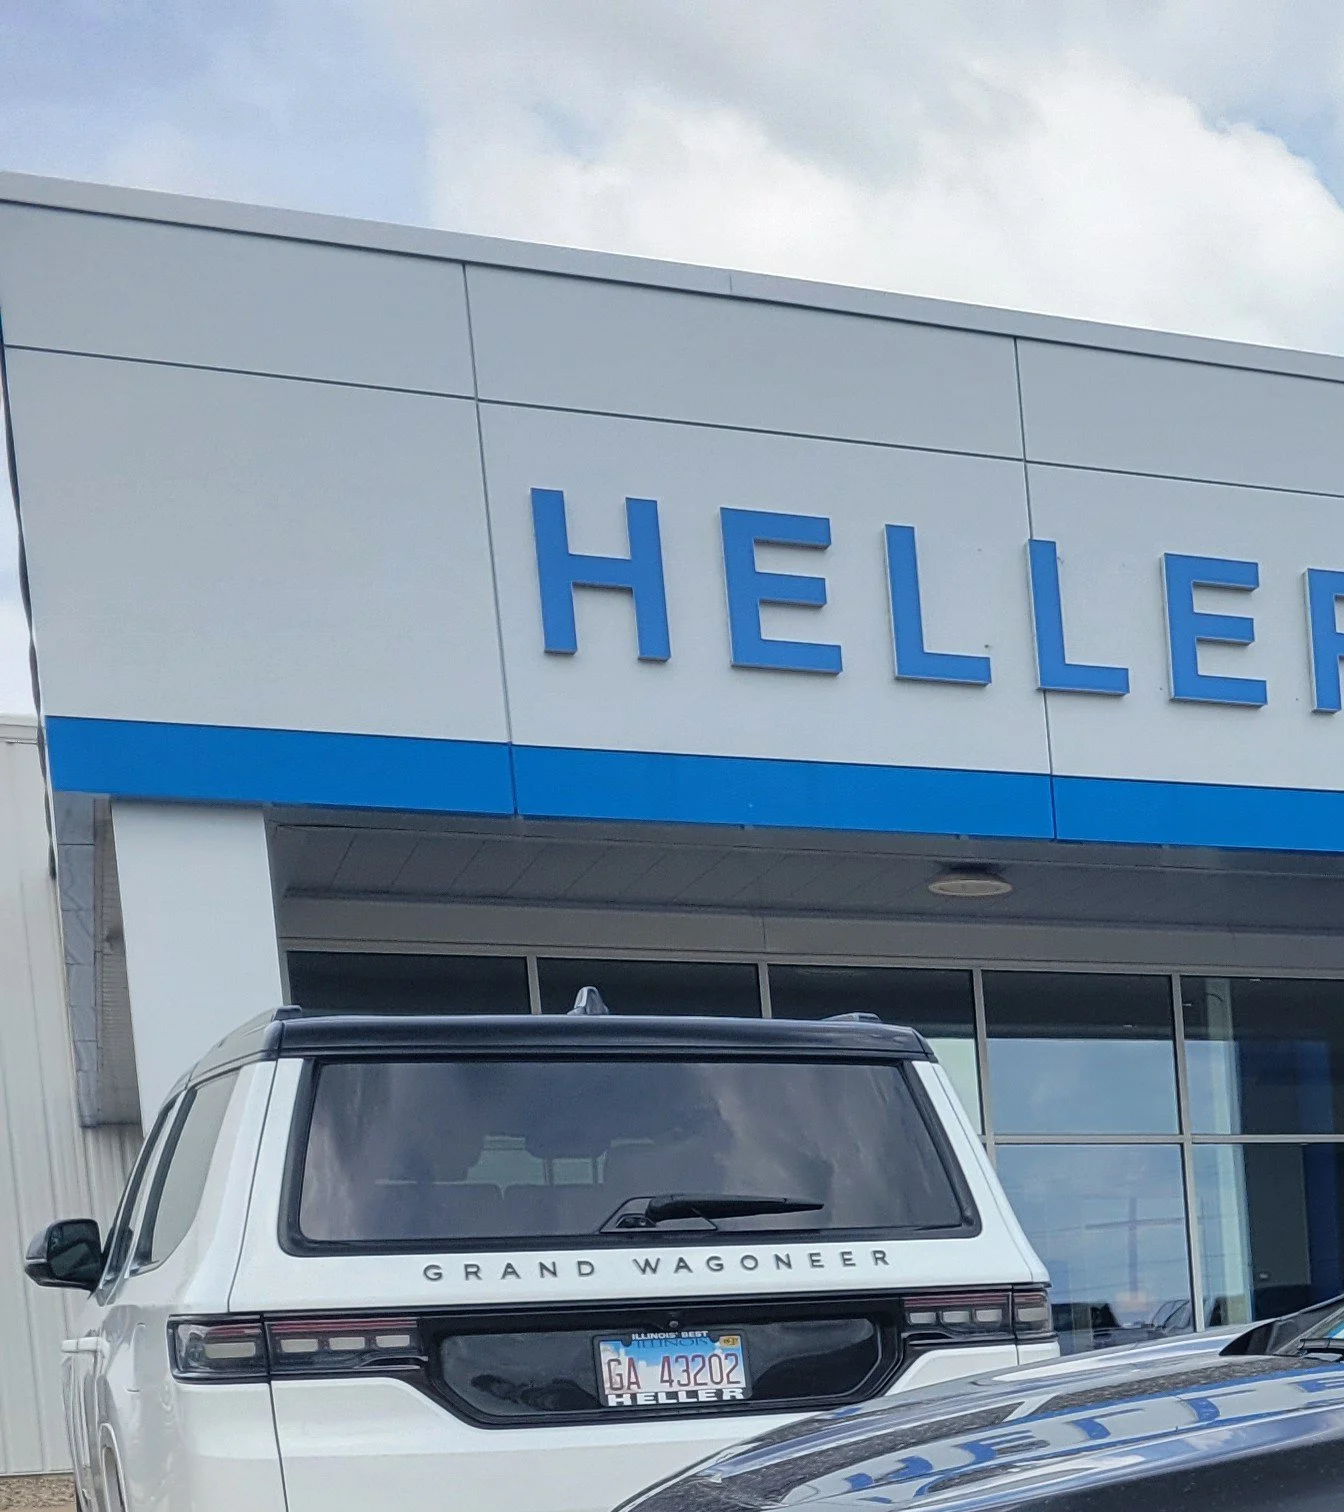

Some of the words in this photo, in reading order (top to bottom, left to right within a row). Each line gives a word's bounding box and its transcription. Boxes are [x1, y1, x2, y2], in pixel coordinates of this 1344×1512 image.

[423, 1259, 596, 1281] GRAND
[632, 1250, 889, 1274] WAGONEER
[681, 1330, 709, 1338] BEST
[607, 1357, 642, 1391] GA
[660, 1352, 741, 1388] 43202
[608, 1388, 745, 1406] HELLER
